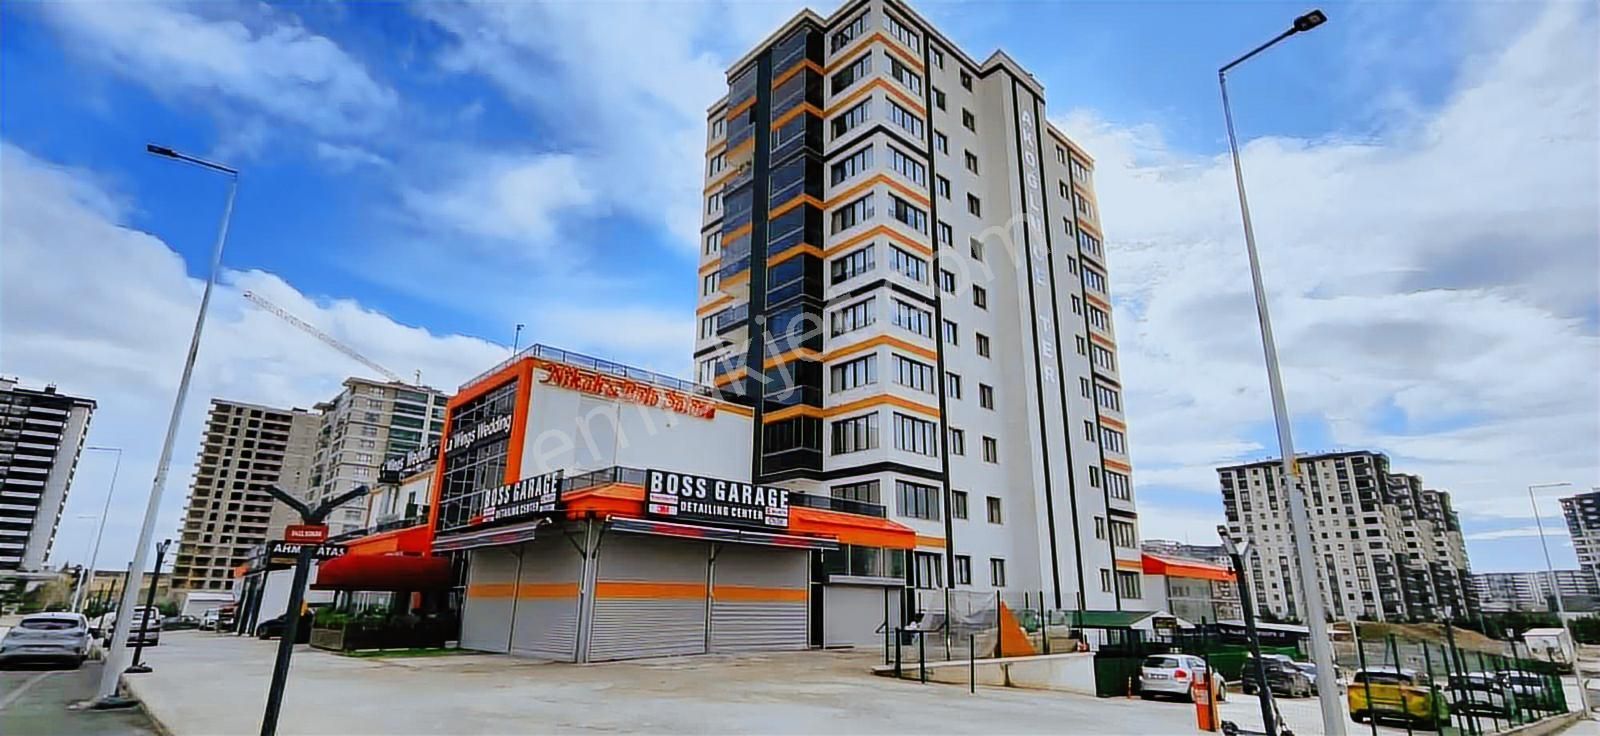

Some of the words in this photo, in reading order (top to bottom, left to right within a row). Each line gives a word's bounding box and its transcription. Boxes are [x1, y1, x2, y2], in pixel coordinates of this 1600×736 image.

[453, 428, 475, 449] Wings
[477, 413, 512, 440] Wedding
[484, 484, 511, 508] BOSS
[512, 471, 558, 502] GARAGE
[650, 471, 706, 498] BOSS
[714, 480, 789, 509] GARAGE
[680, 501, 729, 516] DETAILING
[730, 507, 764, 520] CENTER
[273, 543, 302, 554] AHM
